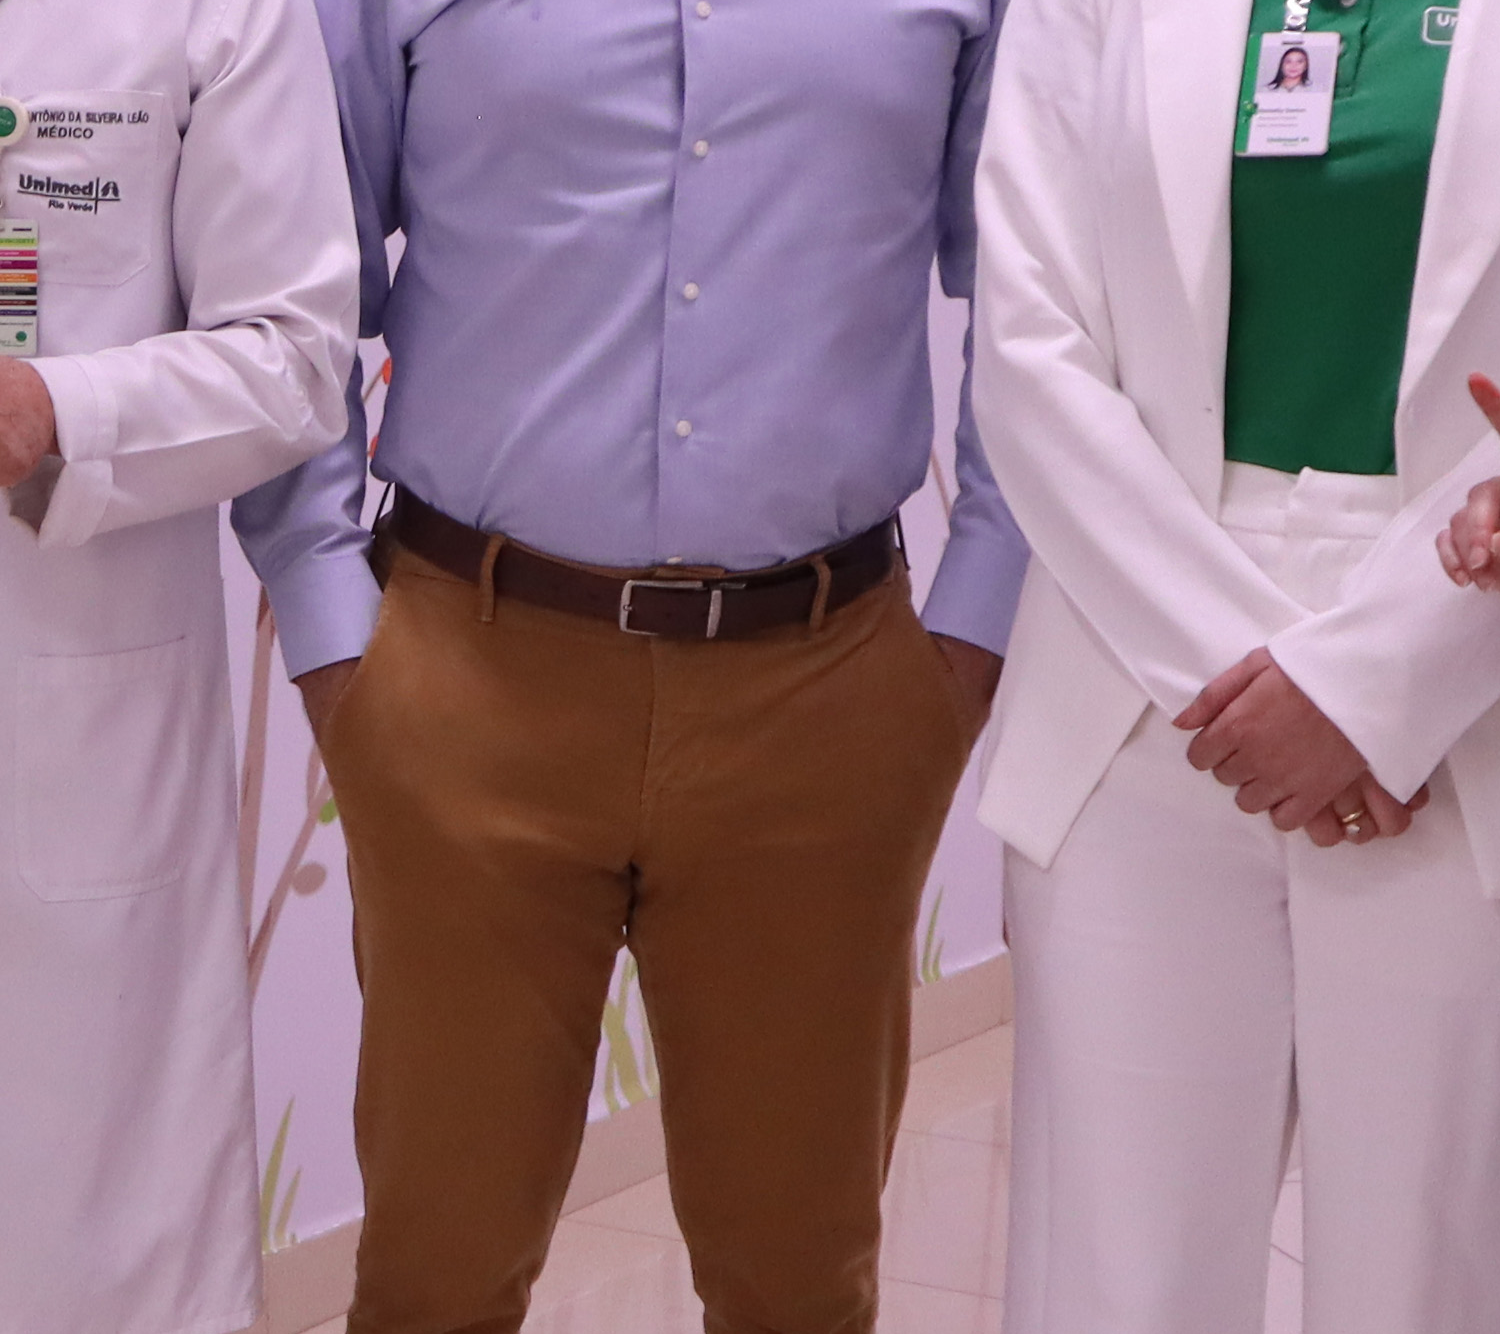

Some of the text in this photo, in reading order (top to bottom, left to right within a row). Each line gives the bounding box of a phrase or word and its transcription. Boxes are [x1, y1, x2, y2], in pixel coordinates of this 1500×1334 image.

[28, 109, 66, 123] NTÔNIO
[68, 110, 82, 123] DA
[85, 112, 124, 124] SILVEIRA
[127, 110, 150, 124] LEÃO
[37, 125, 95, 139] MÉDICO
[19, 173, 94, 196] Unimed
[48, 199, 94, 212] Rio Verde
